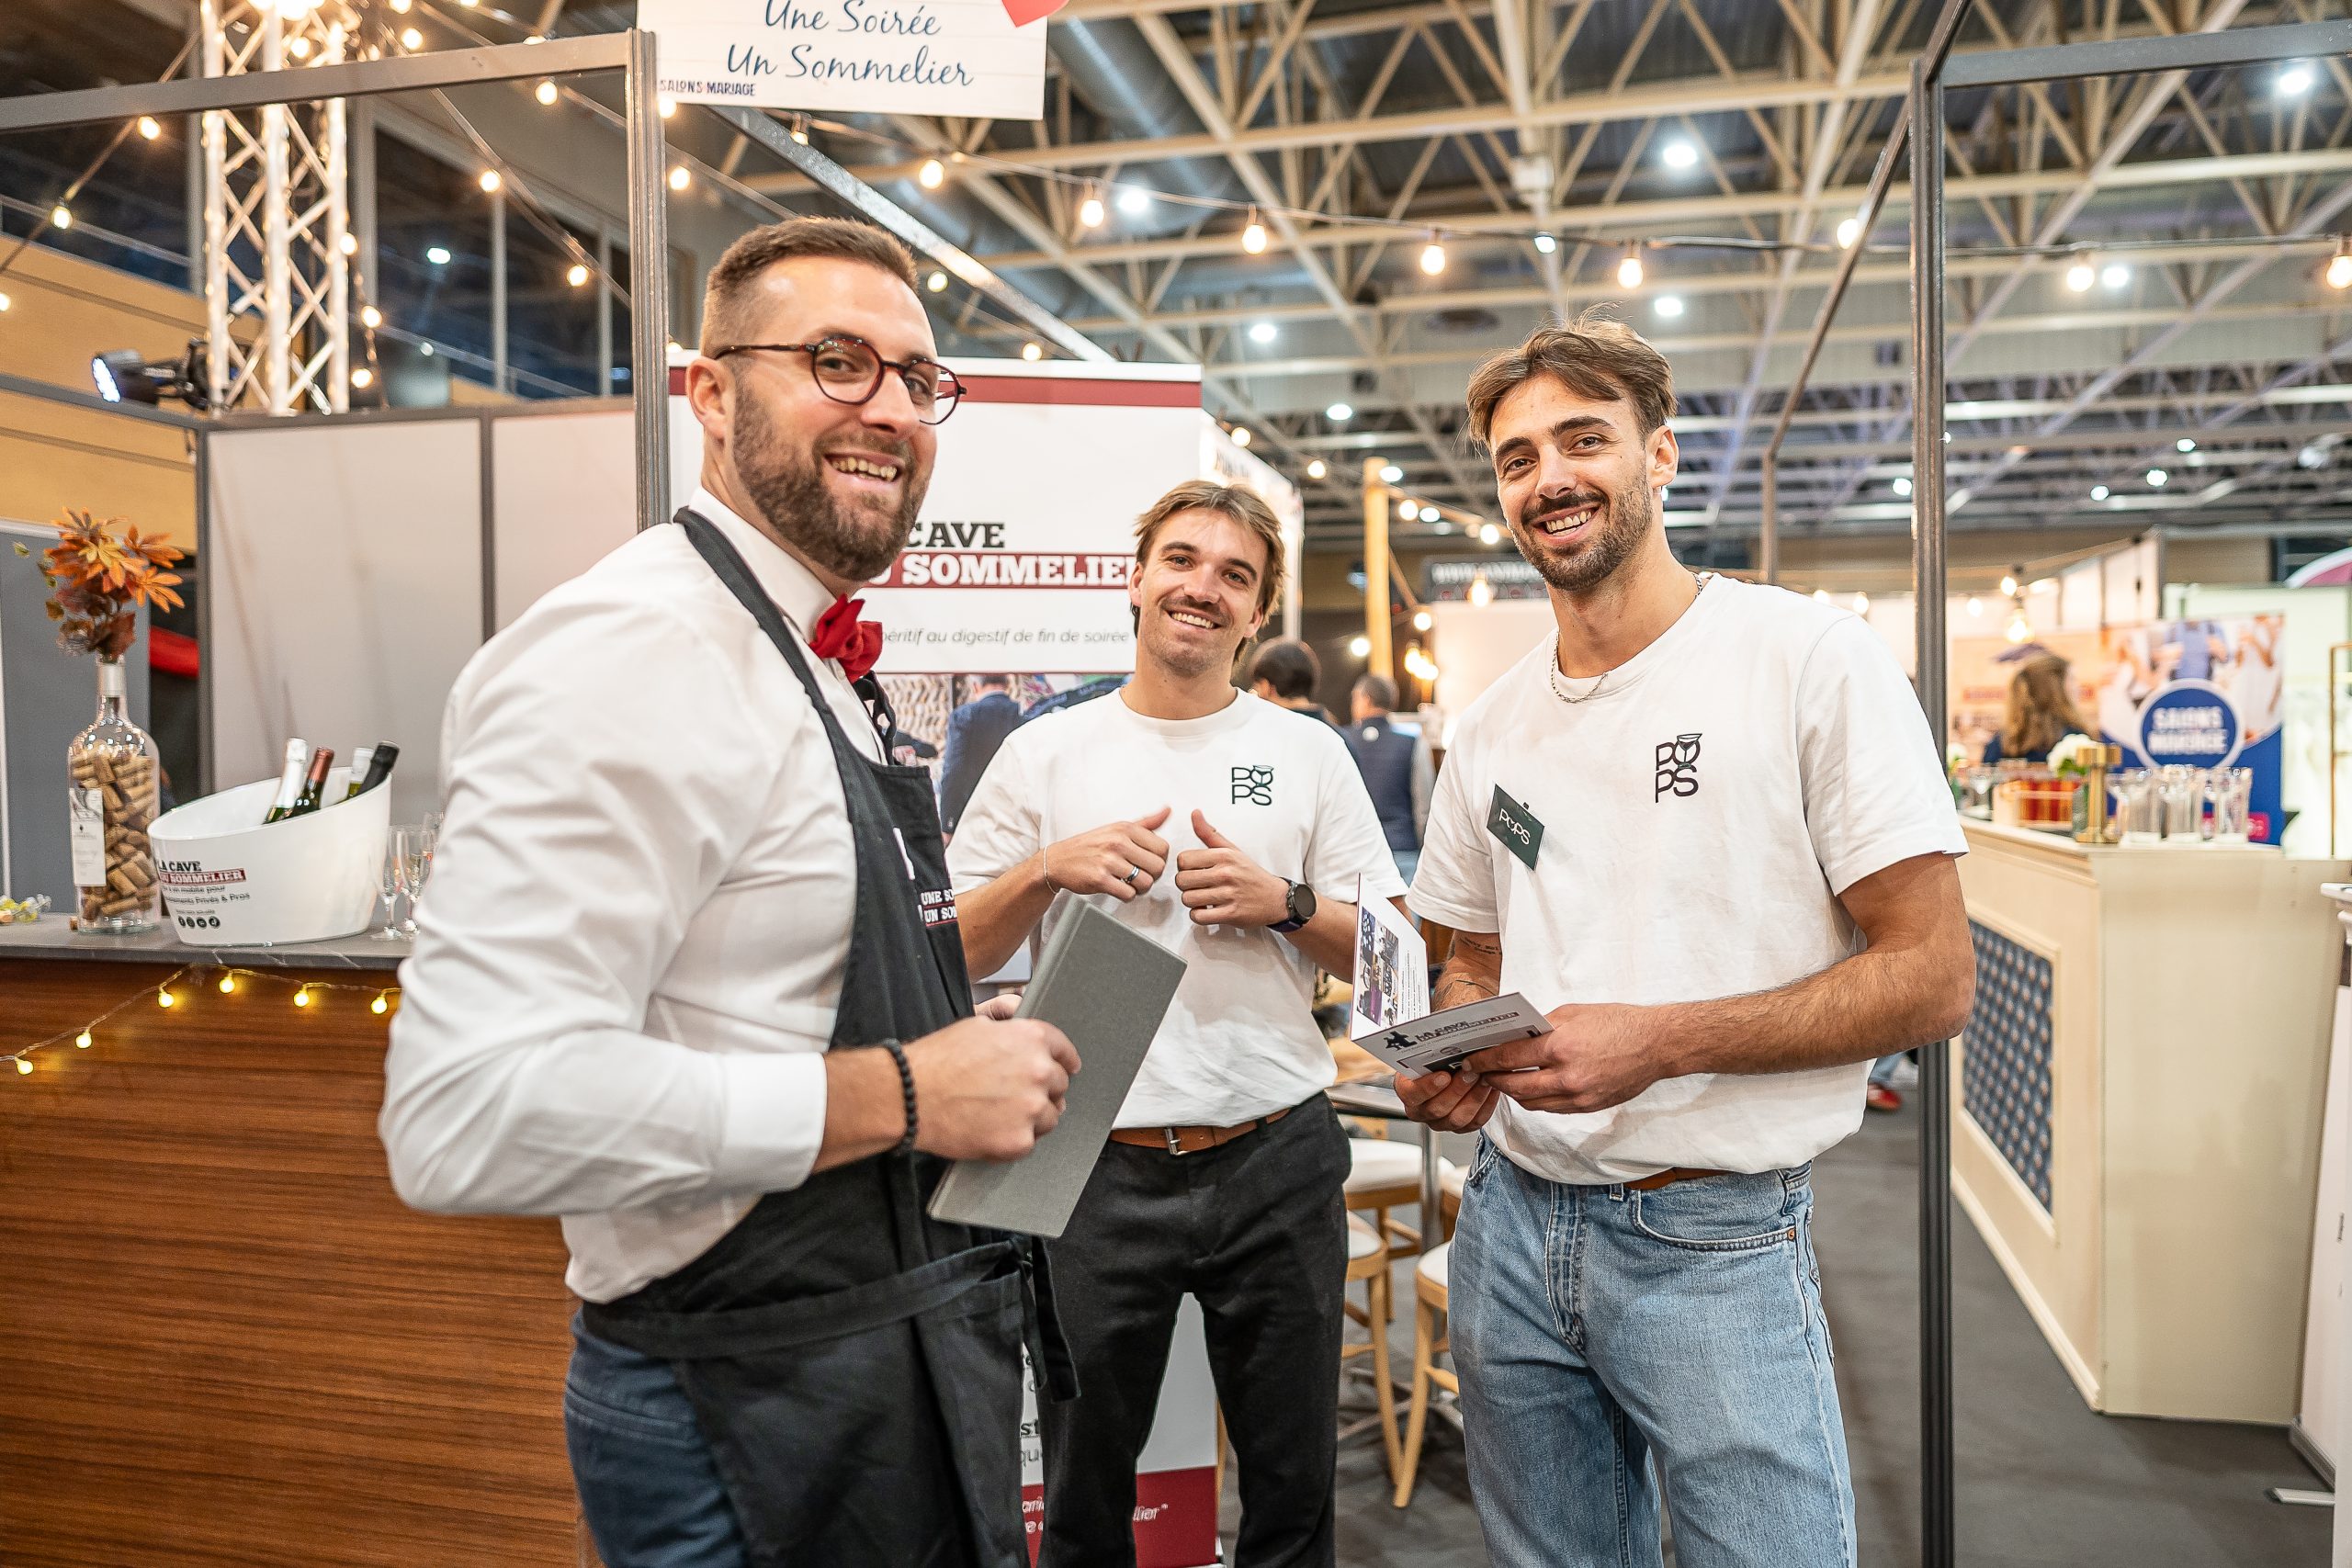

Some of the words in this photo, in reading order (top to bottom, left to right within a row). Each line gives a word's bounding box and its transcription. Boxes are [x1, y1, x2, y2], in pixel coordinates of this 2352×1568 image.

[763, 0, 830, 30] Une
[838, 0, 942, 36] Soirée
[727, 43, 778, 77] Un
[786, 44, 974, 86] Sommelier
[660, 80, 703, 94] SALONS
[707, 81, 756, 96] MARIAGE
[926, 631, 947, 643] au
[952, 628, 1011, 646] digestif
[1013, 628, 1035, 643] de
[1037, 628, 1056, 643] fin
[1060, 628, 1080, 643] de
[1083, 627, 1130, 643] soirée
[1498, 808, 1532, 845] POPS
[168, 861, 202, 872] CAVE
[921, 891, 943, 906] UNE
[923, 908, 939, 923] UN
